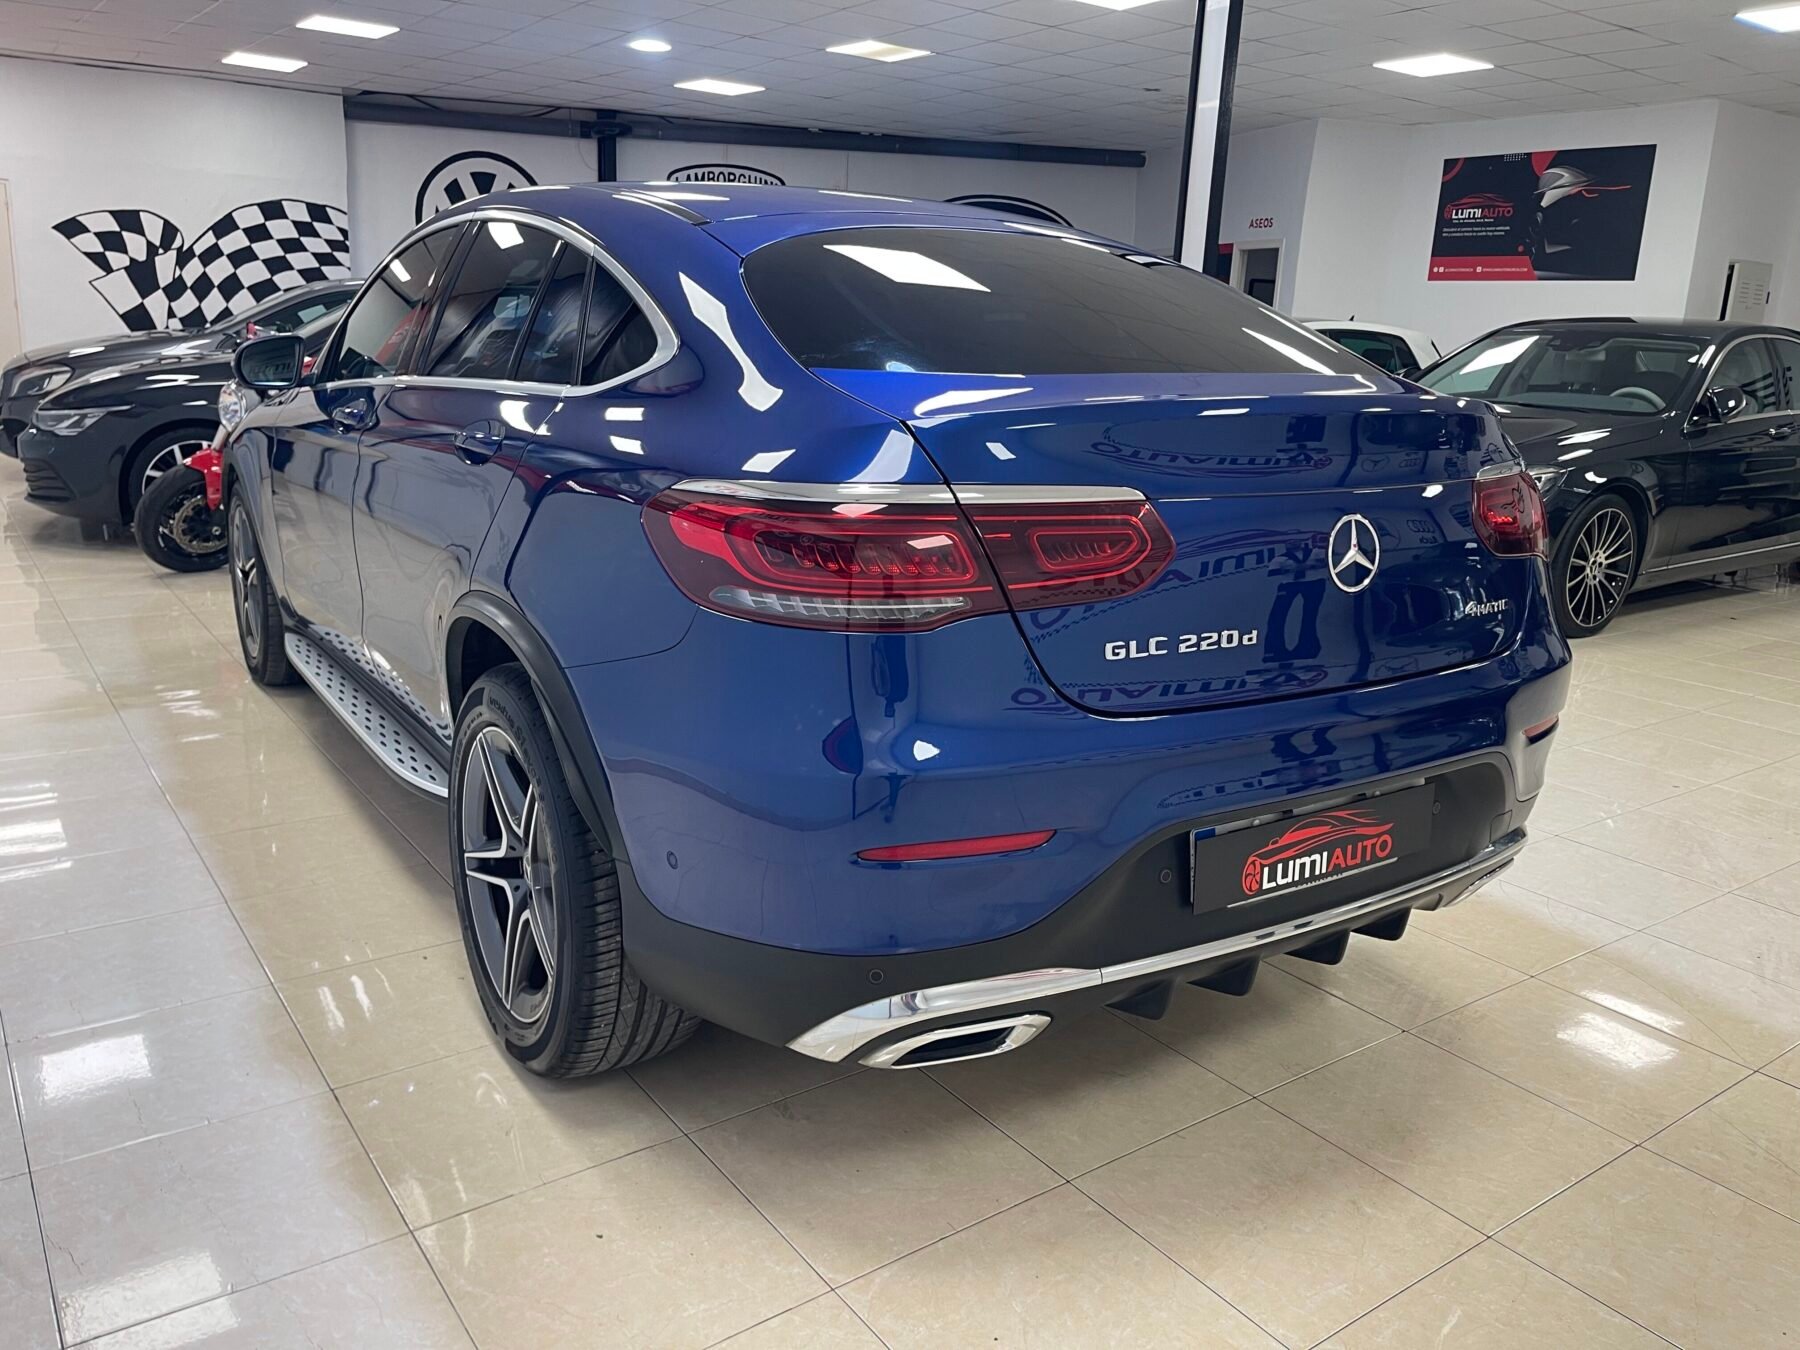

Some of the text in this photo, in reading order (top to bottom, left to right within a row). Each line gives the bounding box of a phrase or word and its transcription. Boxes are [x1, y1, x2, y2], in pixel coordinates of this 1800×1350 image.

[1248, 217, 1274, 229] ASEOS
[1465, 598, 1509, 617] 4MATIC
[1104, 629, 1258, 662] GLC 220d
